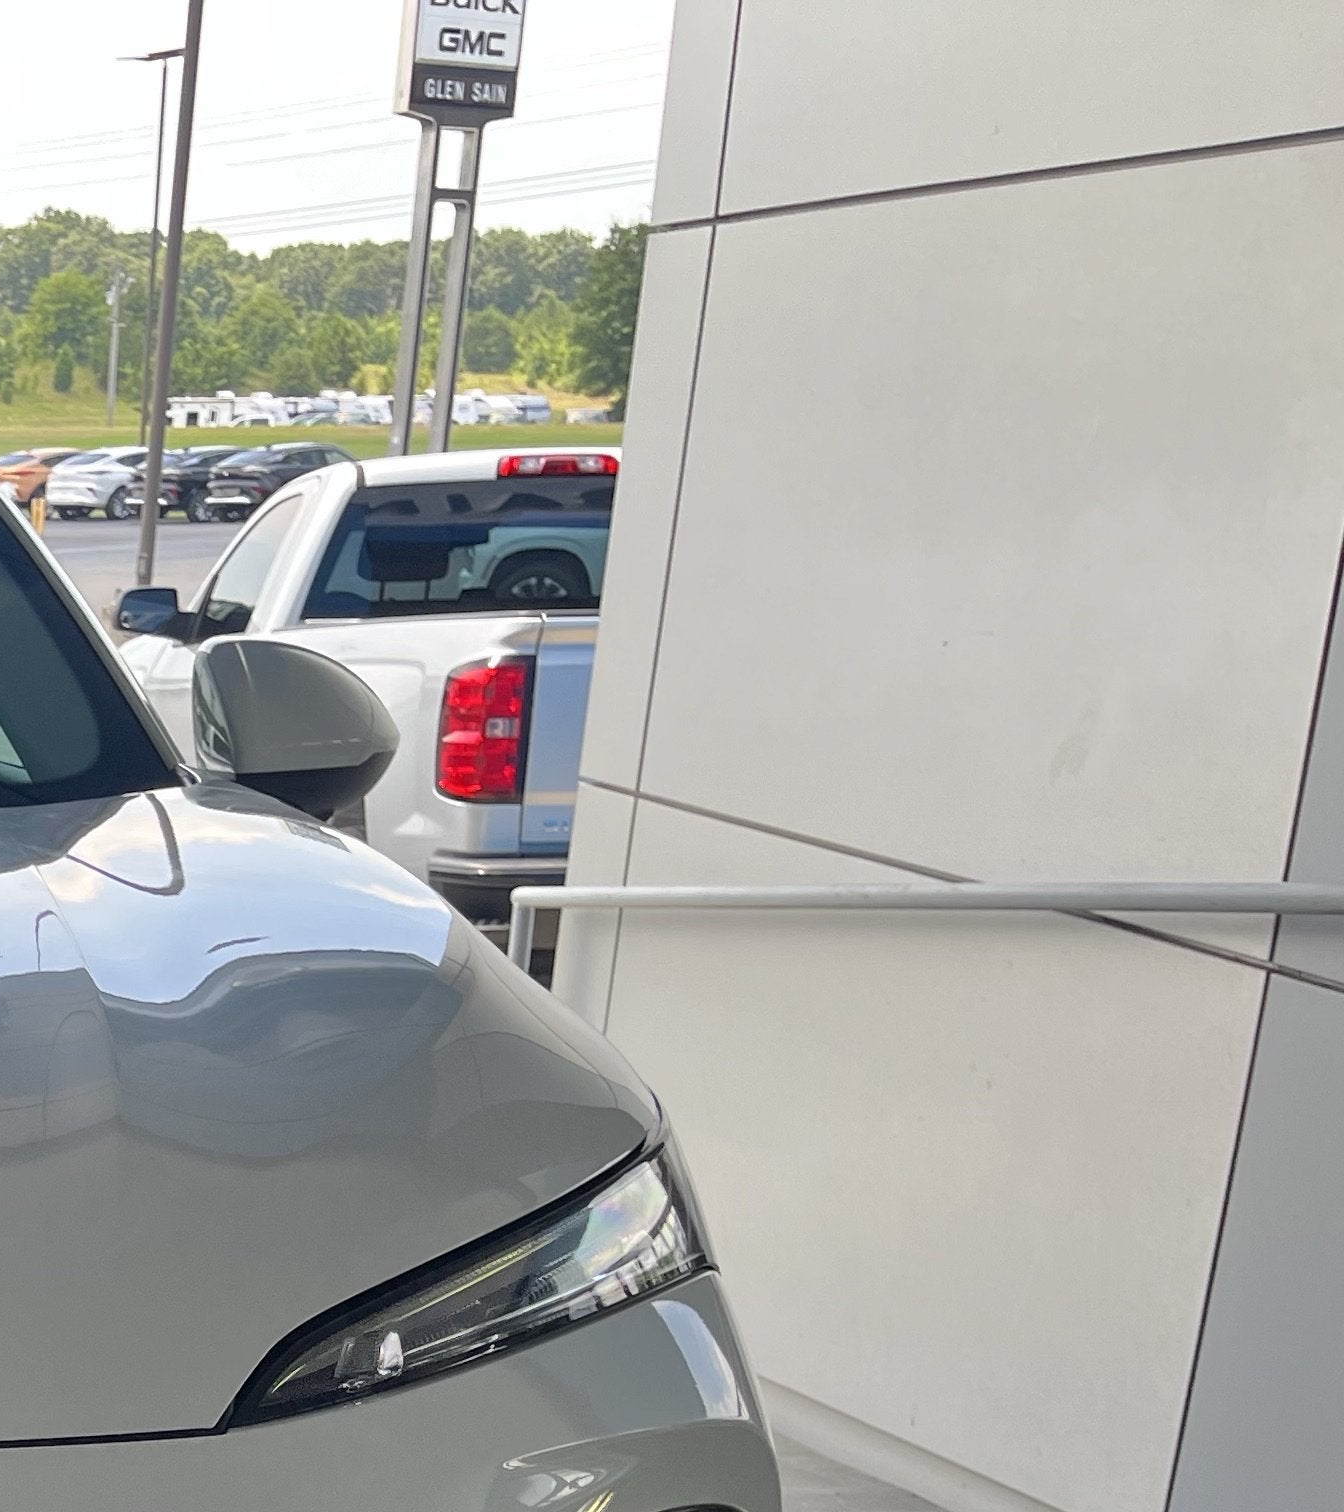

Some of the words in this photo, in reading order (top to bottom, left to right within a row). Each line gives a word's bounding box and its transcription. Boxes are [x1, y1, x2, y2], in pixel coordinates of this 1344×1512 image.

[430, 0, 520, 15] uick
[439, 27, 507, 56] GMC
[423, 78, 465, 101] GLEN
[471, 82, 507, 104] SAIN
